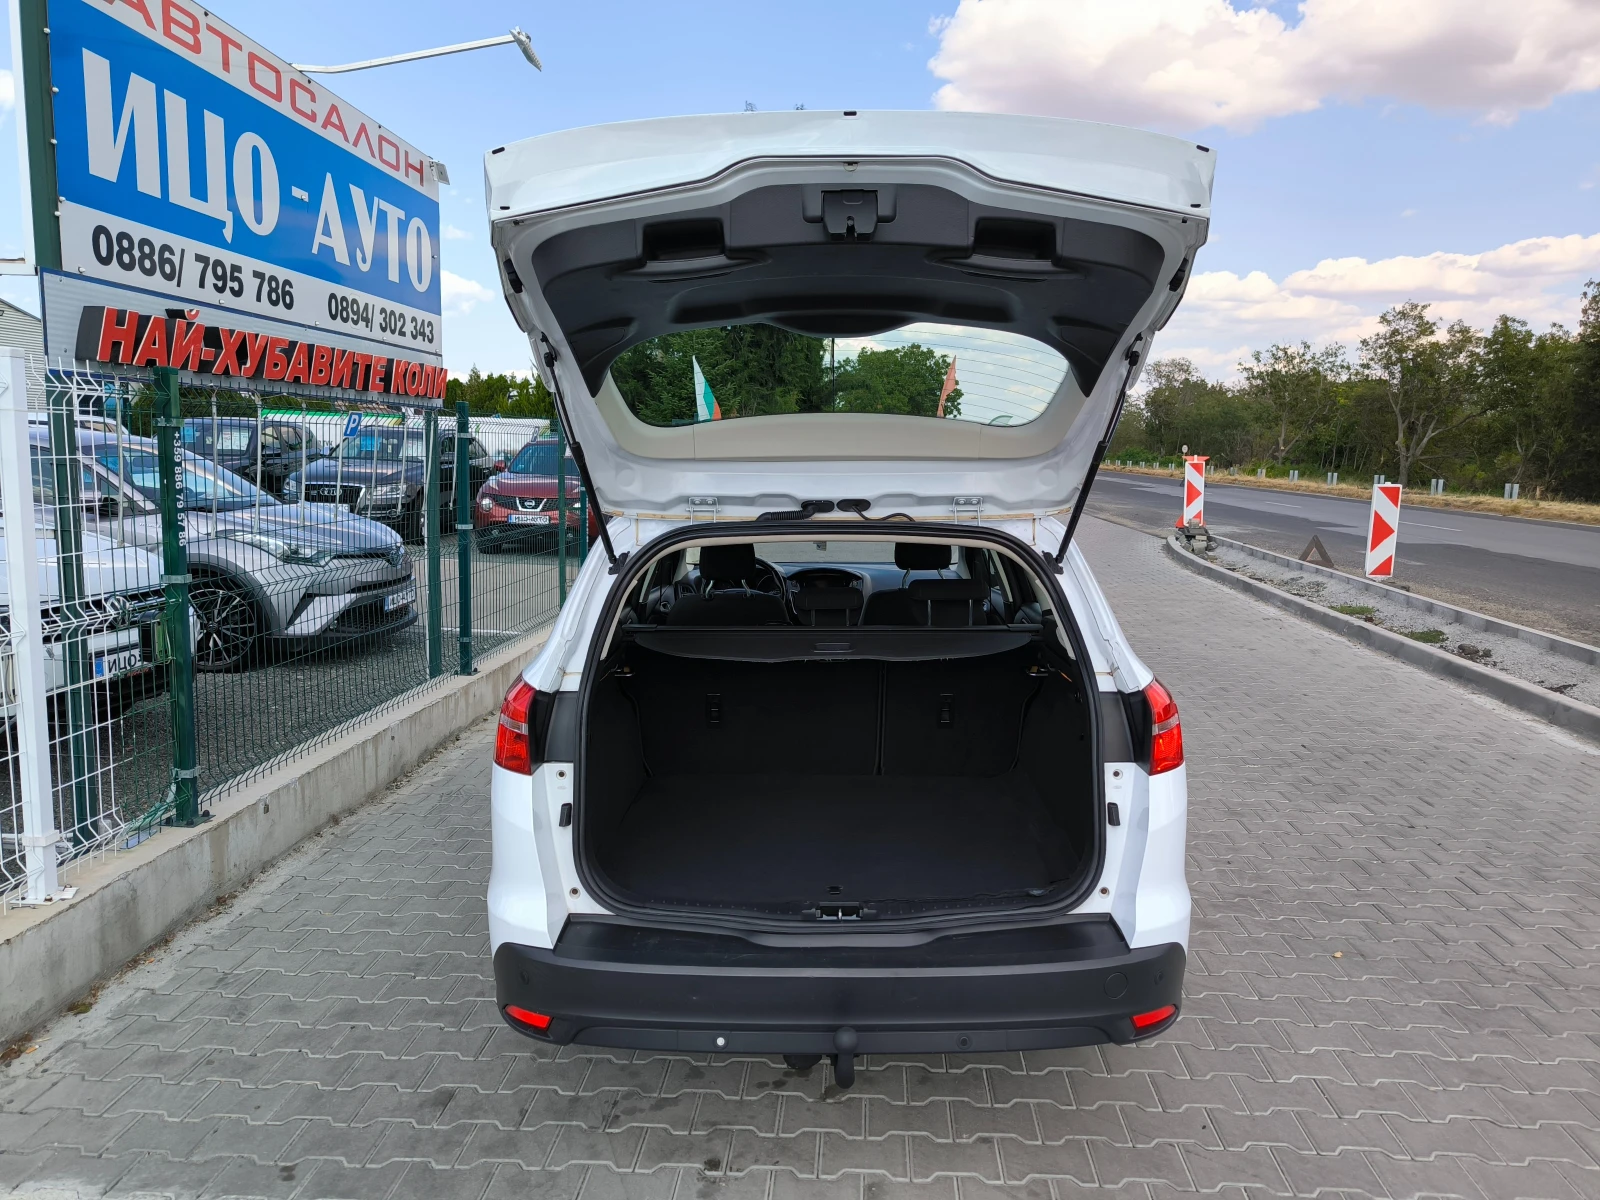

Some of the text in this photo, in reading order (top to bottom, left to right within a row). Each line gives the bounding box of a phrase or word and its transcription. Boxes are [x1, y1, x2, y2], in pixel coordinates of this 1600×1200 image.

[92, 225, 294, 310] 0886/ 795 786
[97, 306, 448, 399] НАЙ-ХУБАВИТЕ КОЛИ
[328, 292, 435, 344] 0894/ 302 343
[347, 415, 359, 434] P
[173, 431, 187, 547] +359 886 79 57 86
